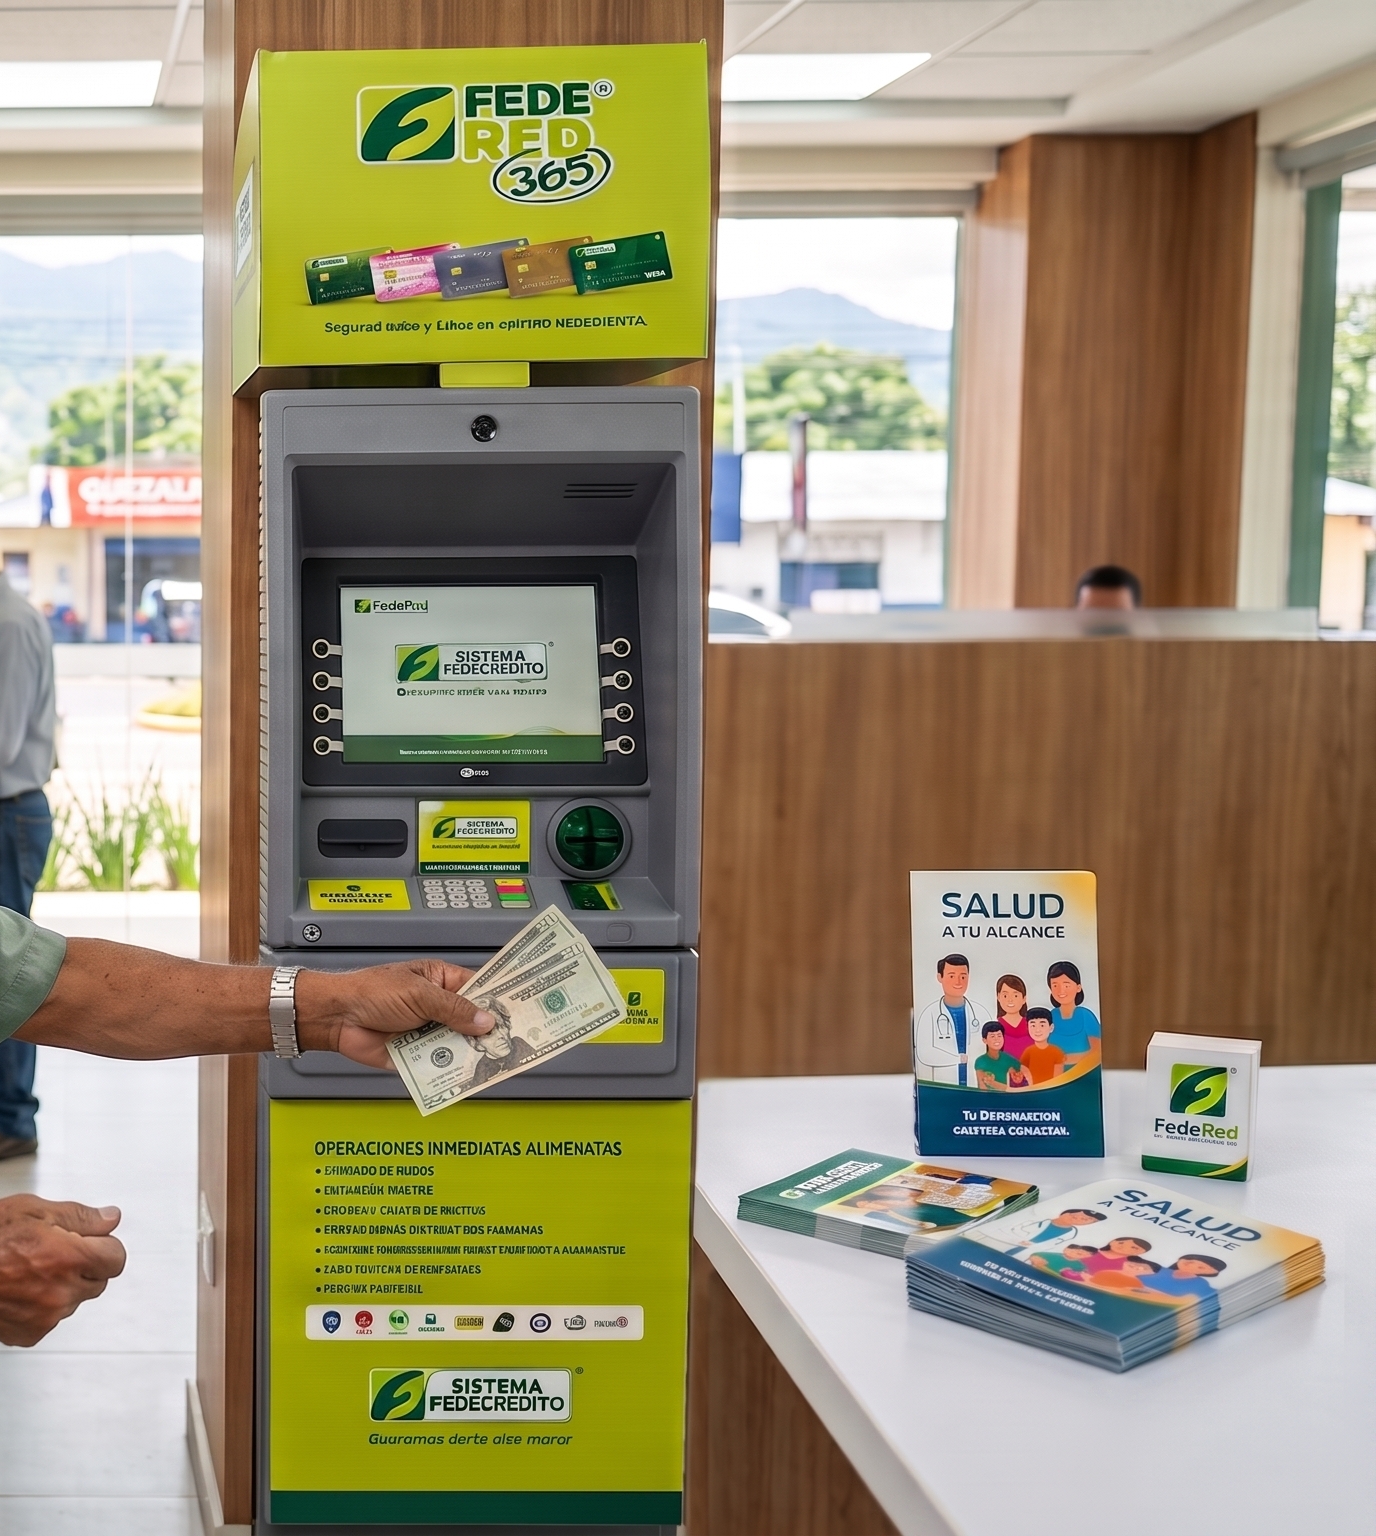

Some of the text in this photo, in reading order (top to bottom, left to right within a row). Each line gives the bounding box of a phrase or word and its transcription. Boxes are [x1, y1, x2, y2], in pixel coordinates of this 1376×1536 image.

[465, 82, 591, 118] FEDE
[463, 118, 592, 161] RED
[508, 153, 594, 197] 365
[324, 320, 382, 336] Segurad
[477, 321, 494, 330] en
[455, 650, 526, 663] SISTEMA
[444, 662, 544, 675] FEDECREDITO
[941, 892, 1065, 919] SALUD
[942, 926, 1066, 938] A TU ALCANCE
[1154, 1117, 1238, 1140] FedeRed
[314, 1141, 622, 1156] OPERACIONES INMEDIATAS ALIMENATAS
[379, 1166, 394, 1176] DE
[424, 1206, 438, 1216] DE
[1096, 1200, 1114, 1208] A
[1113, 1189, 1262, 1242] SALUD
[452, 1378, 543, 1394] SISTEMA
[429, 1396, 564, 1412] FEDECREDITO
